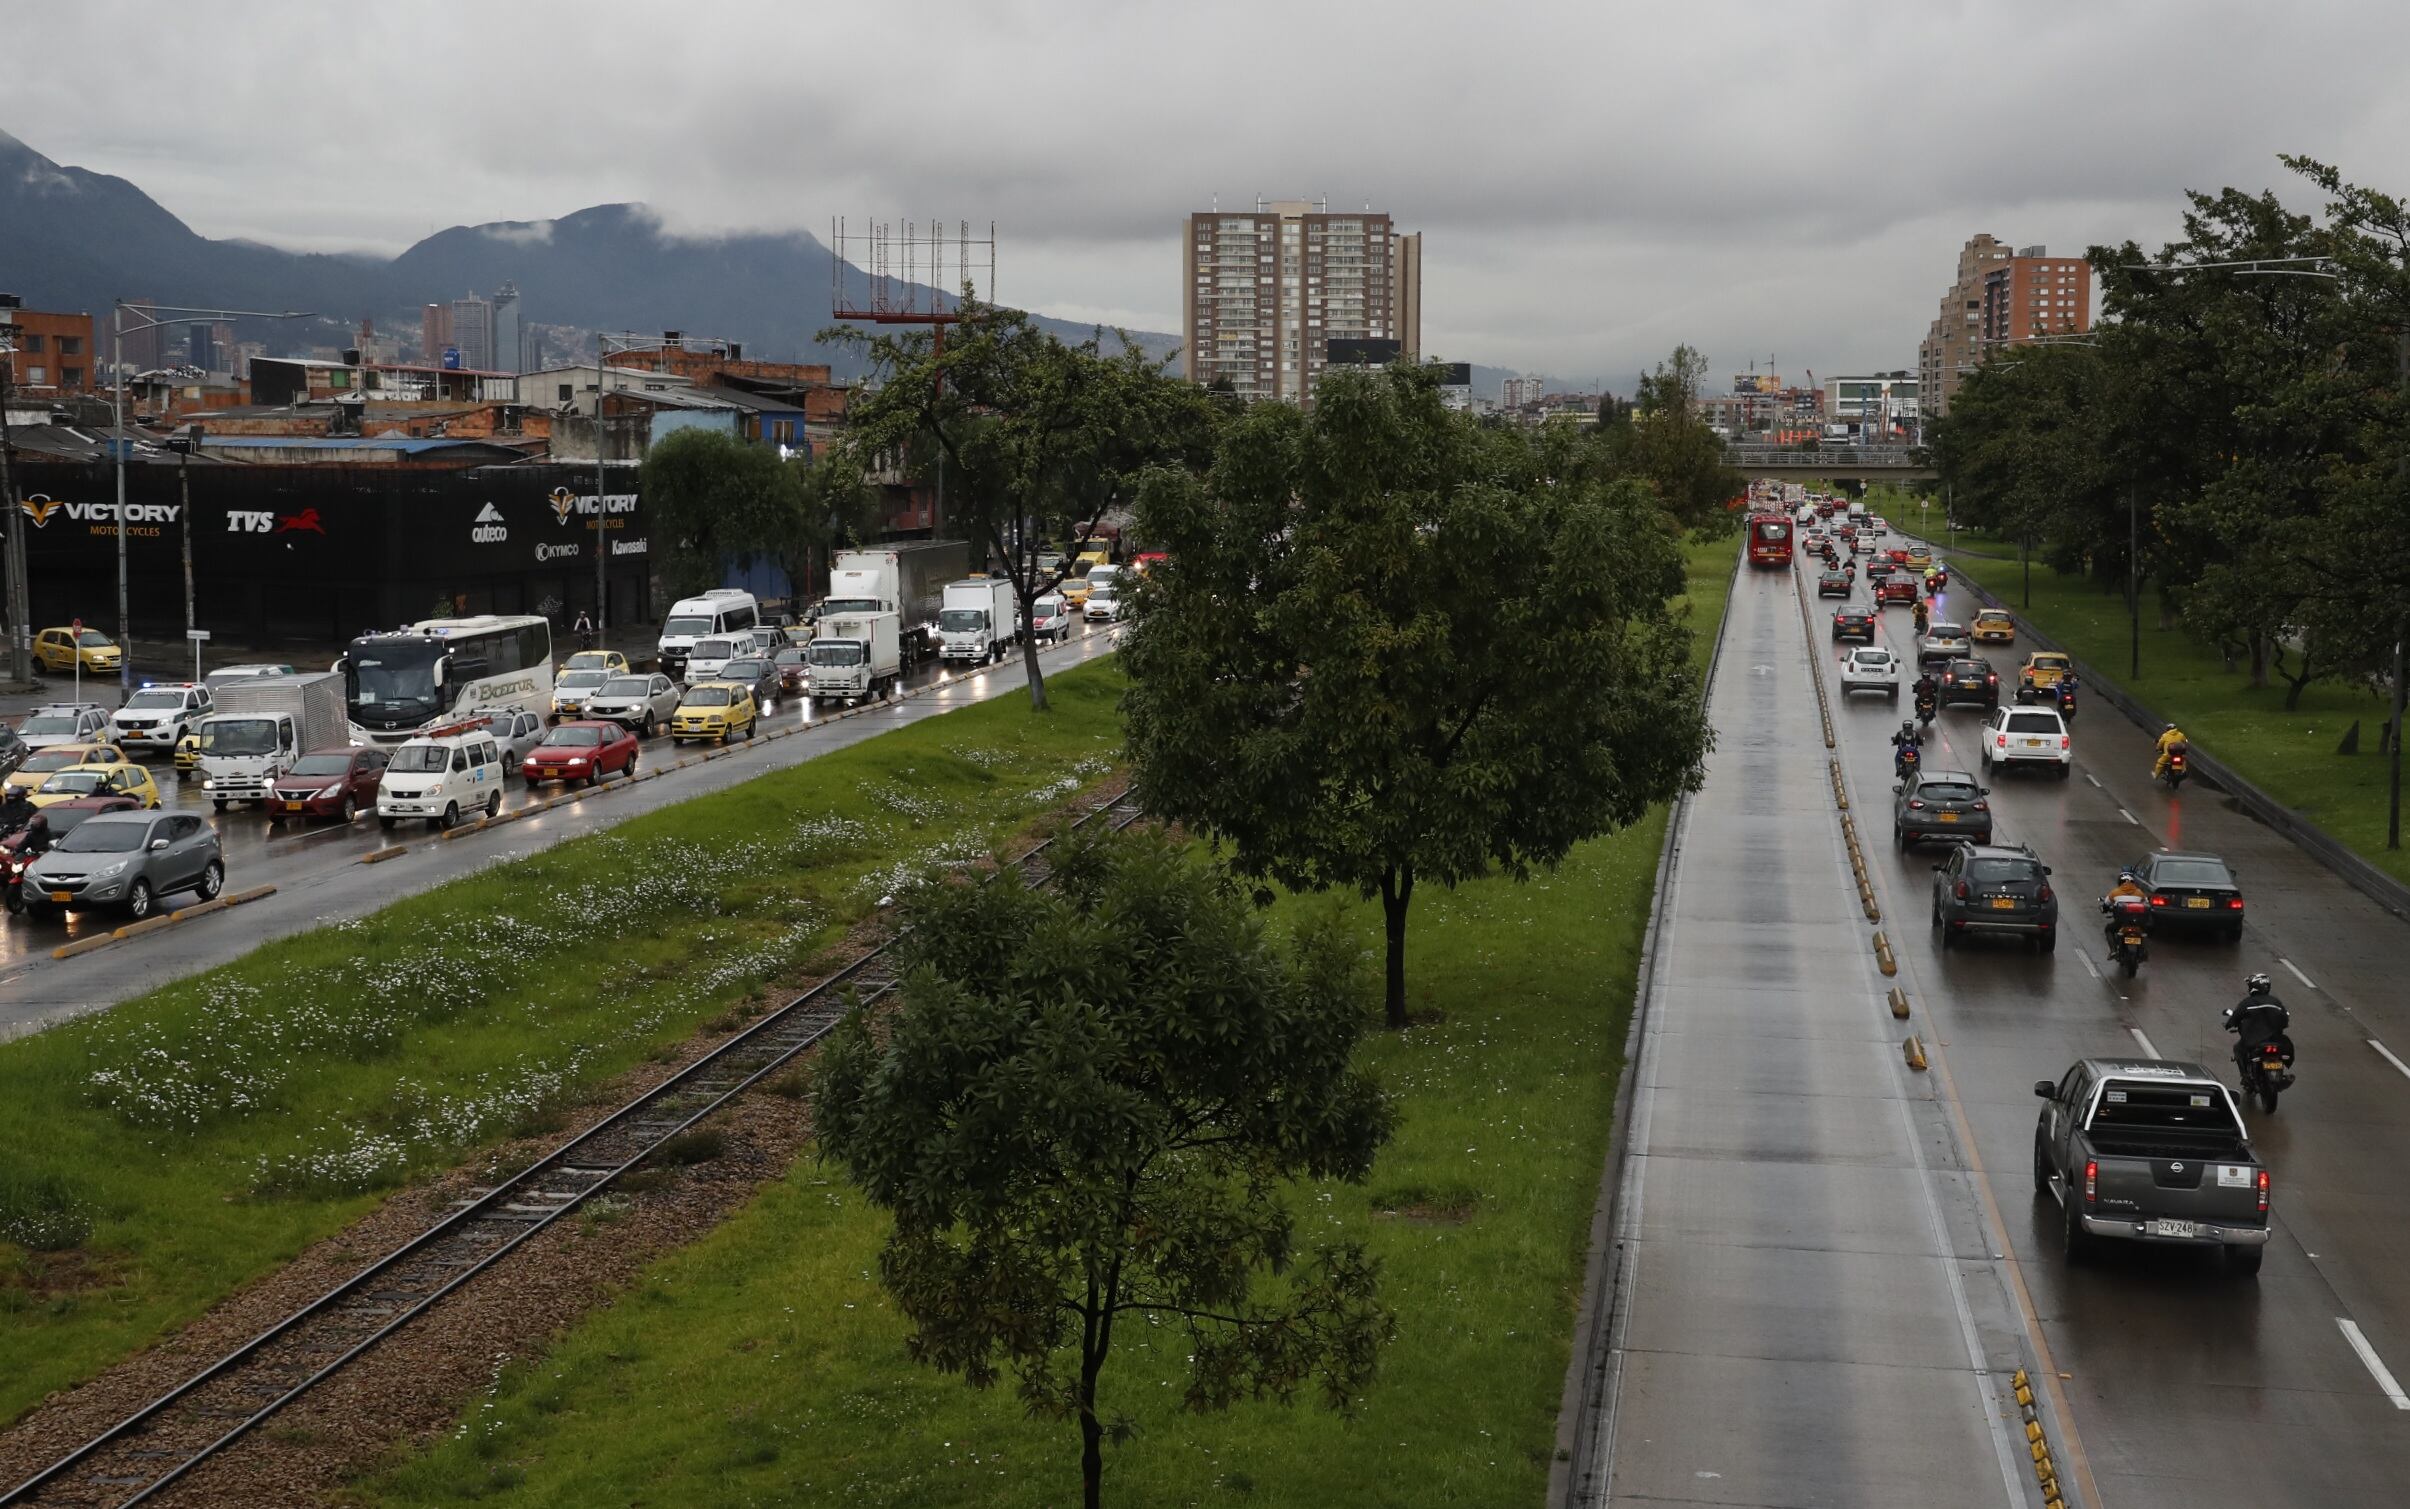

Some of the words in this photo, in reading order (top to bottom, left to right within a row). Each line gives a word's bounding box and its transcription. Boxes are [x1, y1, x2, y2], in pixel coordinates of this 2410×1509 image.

[64, 502, 180, 521] VICTORY
[575, 494, 638, 514] VICTORY
[226, 510, 275, 533] TVS
[90, 526, 160, 536] MOTOCYCLES
[472, 525, 507, 542] auteco
[549, 543, 579, 557] KYMCO
[612, 537, 648, 555] Kawasaki
